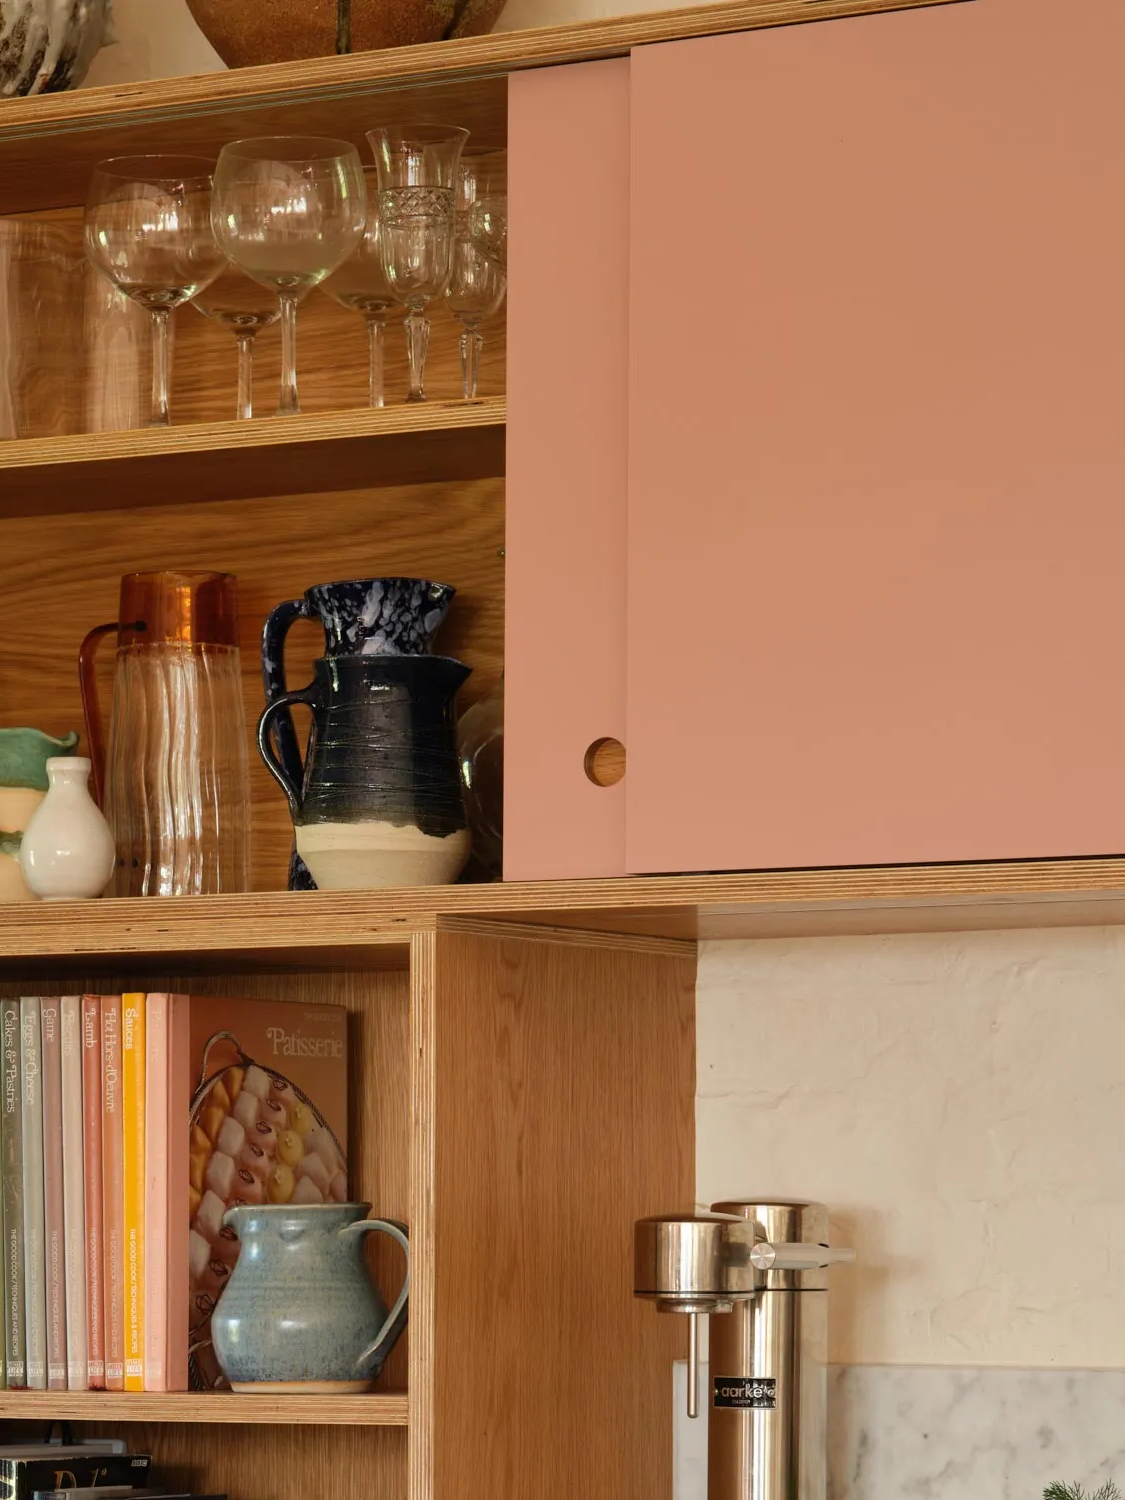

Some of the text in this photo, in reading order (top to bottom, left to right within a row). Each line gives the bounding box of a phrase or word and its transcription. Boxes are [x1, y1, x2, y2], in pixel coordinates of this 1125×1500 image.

[42, 1008, 56, 1042] Game
[85, 1007, 97, 1048] Lamb
[105, 1008, 116, 1033] Hot
[125, 1007, 138, 1050] Sauces
[22, 1010, 38, 1106] Eggs & Cheese
[266, 1027, 343, 1058] Patisserie
[4, 1010, 18, 1113] Cakes & Pastries
[722, 1384, 763, 1398] aarke
